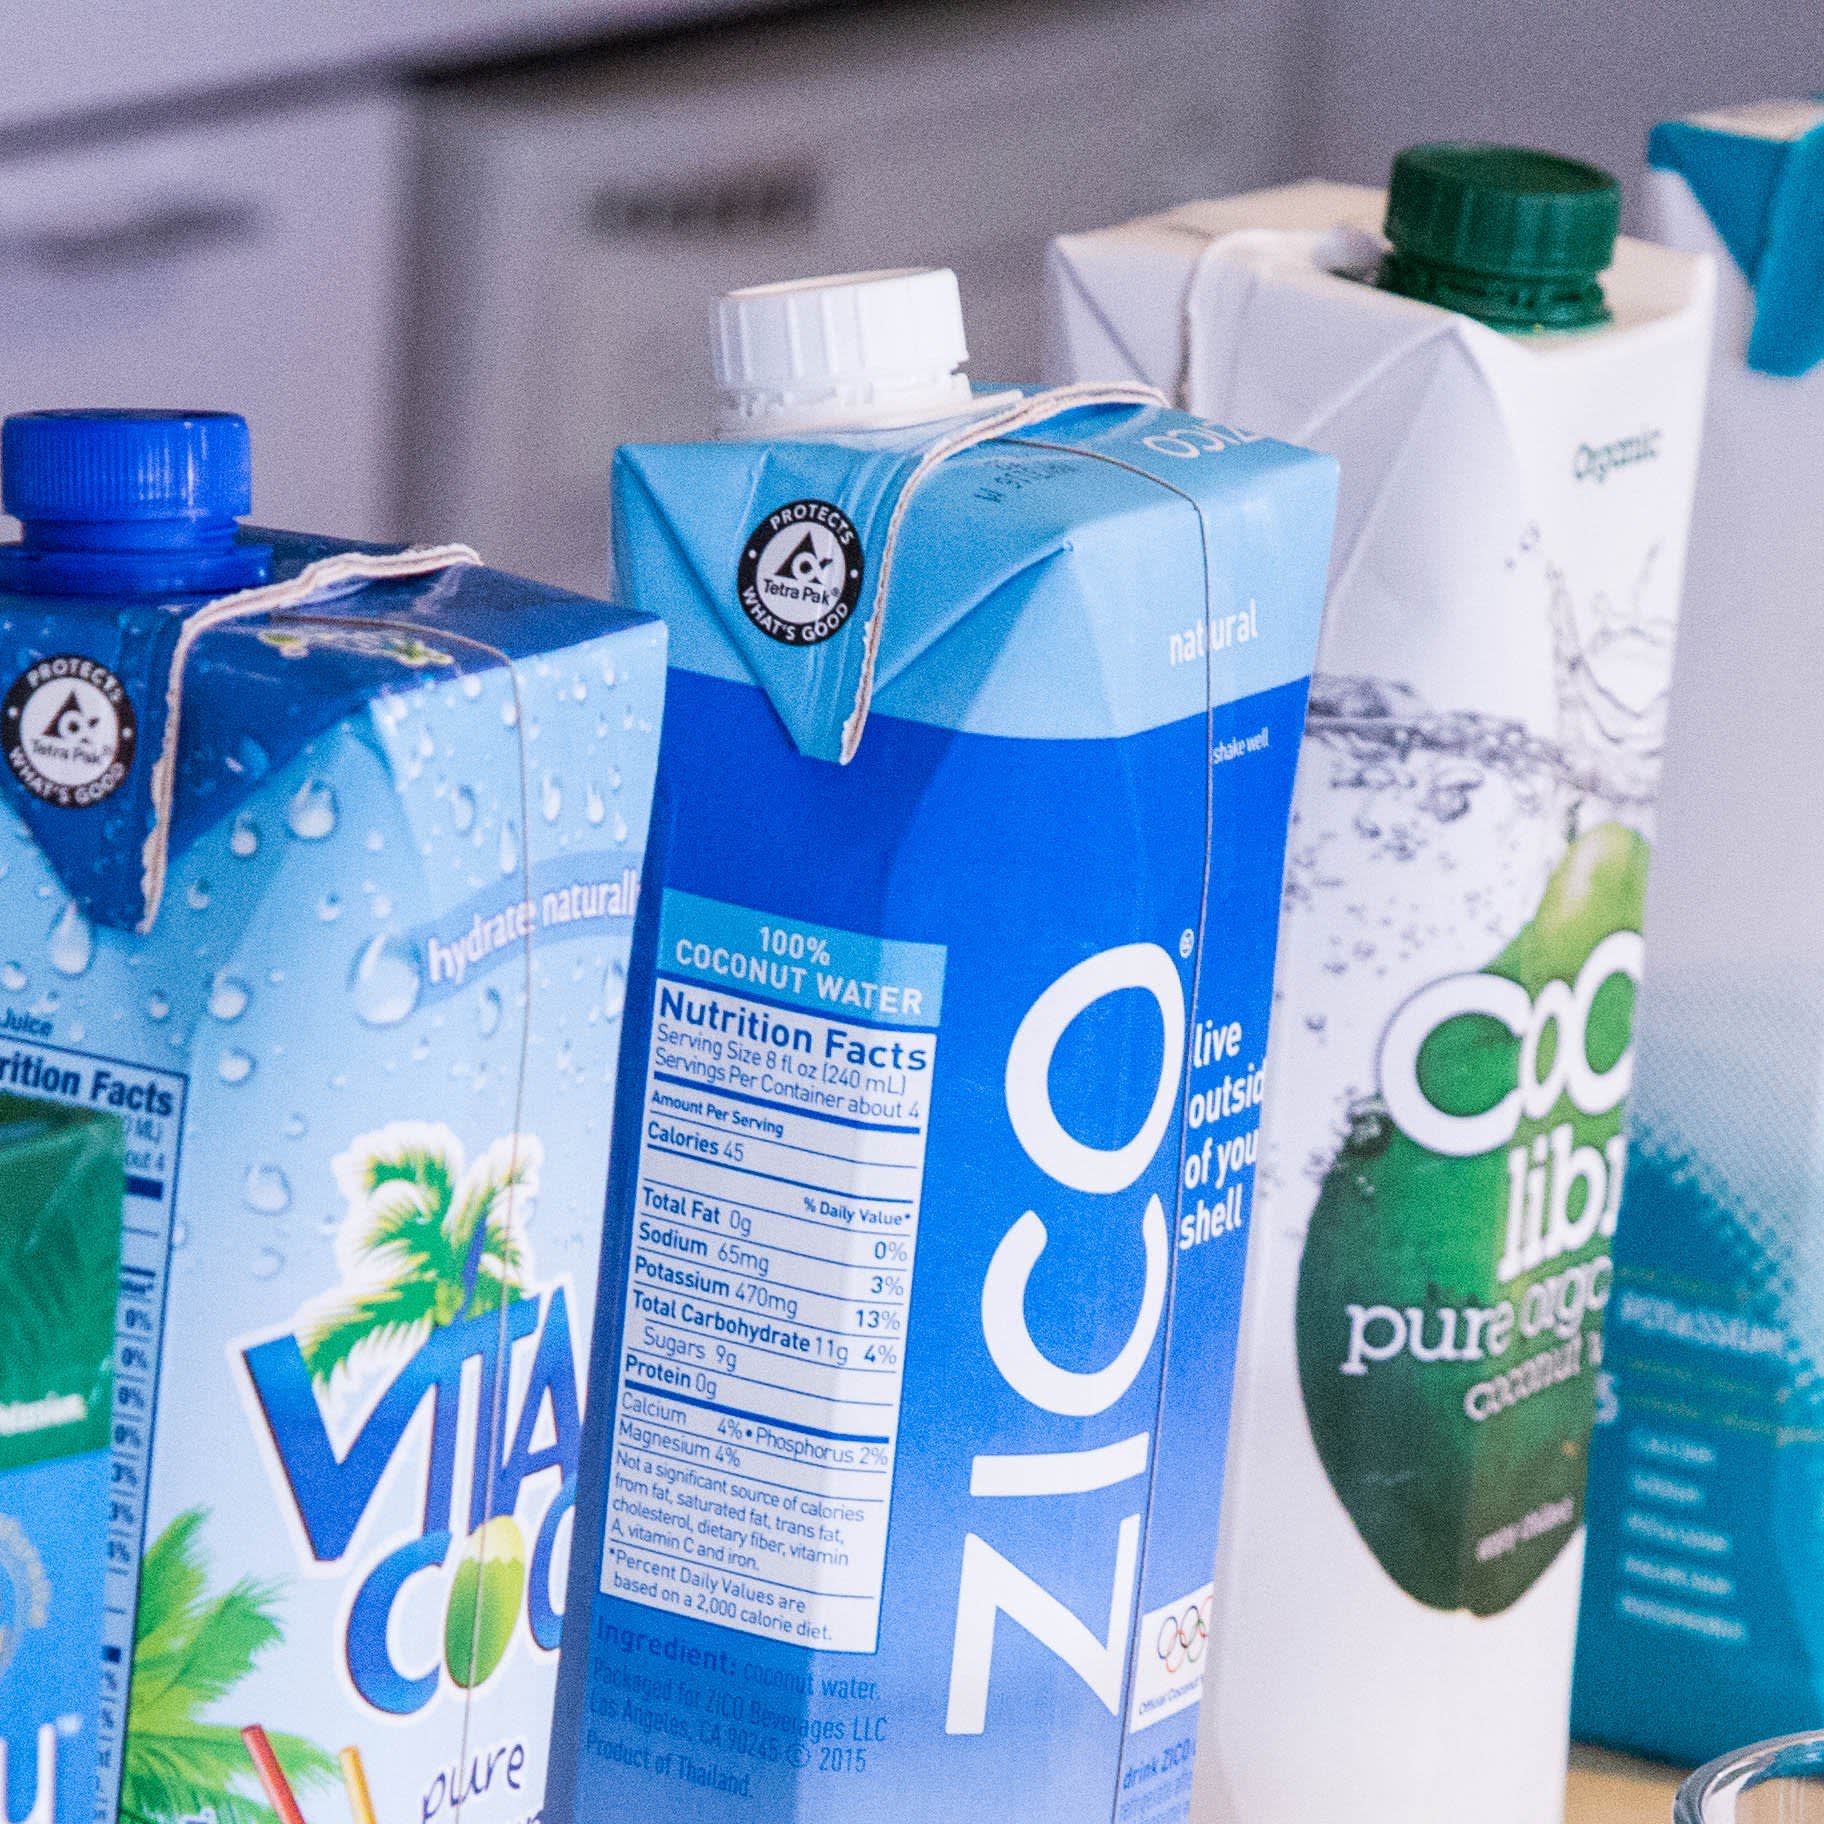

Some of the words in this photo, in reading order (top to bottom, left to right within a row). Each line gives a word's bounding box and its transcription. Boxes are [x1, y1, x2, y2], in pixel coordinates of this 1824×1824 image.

[770, 504, 854, 545] PROTECTS
[743, 586, 795, 640] WHAT'S
[802, 603, 848, 641] GOOD
[764, 579, 799, 599] Tetra
[803, 587, 830, 605] Pak
[1170, 598, 1258, 666] natural
[27, 659, 123, 702] PROTECTS
[1214, 736, 1245, 764] shake
[1247, 726, 1269, 752] well
[75, 762, 125, 805] GOOD
[428, 891, 534, 984] hydrate
[760, 926, 830, 966] 100%
[676, 938, 807, 993] COCONUT
[817, 971, 922, 1015] WATER
[0, 1007, 54, 1037] Juice
[657, 1023, 721, 1061] Serving
[728, 1041, 762, 1065] Size
[767, 1051, 776, 1069] 8
[781, 1054, 792, 1074] fl
[797, 1063, 816, 1078] oz
[660, 987, 812, 1053] Nutrition
[827, 1029, 926, 1071] Facts
[1193, 1020, 1241, 1069] live
[91, 1070, 174, 1116] Facts
[656, 1048, 724, 1082] Servings
[729, 1068, 757, 1088] Per
[761, 1076, 843, 1110] Container
[848, 1094, 901, 1119] about
[909, 1101, 919, 1118] 4
[1188, 1059, 1266, 1130] outsid
[648, 1122, 719, 1155] Calories
[723, 1143, 744, 1161] 45
[652, 1091, 703, 1117] Amount
[707, 1103, 728, 1121] Per
[732, 1111, 784, 1138] Serving
[1184, 1144, 1214, 1188] of
[643, 1187, 688, 1216] Total
[692, 1201, 719, 1224] Fat
[729, 1209, 751, 1236] 0g
[874, 1241, 907, 1262] 0%
[804, 1197, 816, 1213] %
[820, 1201, 855, 1222] Daily
[1178, 1195, 1242, 1251] shell
[638, 1222, 707, 1256] Sodium
[717, 1242, 769, 1276] 65mg
[871, 1276, 904, 1296] 3%
[634, 1256, 729, 1297] Potassium
[735, 1282, 797, 1318] 470mg
[855, 1310, 900, 1330] 13%
[633, 1290, 675, 1318] Total
[681, 1305, 810, 1351] Carbohydrate
[816, 1338, 848, 1367] 11g
[864, 1345, 896, 1363] 4%
[643, 1327, 705, 1359] Sugars
[715, 1346, 737, 1371] 9g
[946, 942, 1185, 1735] ZICO
[1341, 1299, 1515, 1376] pure
[626, 1355, 691, 1388] Protein
[696, 1372, 717, 1399] 0g
[619, 1420, 710, 1459] Magnesium
[714, 1445, 740, 1467] 4%
[622, 1392, 687, 1424] Calcium
[717, 1418, 742, 1440] 4%
[756, 1422, 854, 1463] Phosphorus
[859, 1446, 888, 1466] 2%
[616, 1473, 648, 1496] from
[652, 1482, 670, 1504] fat,
[677, 1490, 746, 1521] saturated
[750, 1508, 771, 1529] fat,
[775, 1517, 814, 1538] trans
[819, 1523, 844, 1544] fat,
[617, 1451, 641, 1472] Not
[644, 1460, 652, 1474] a
[656, 1460, 727, 1495] significant
[730, 1484, 780, 1506] source
[783, 1492, 797, 1512] of
[800, 1498, 864, 1521] calories
[611, 1519, 624, 1538] A,
[628, 1526, 680, 1548] vitamin
[683, 1538, 695, 1553] C
[697, 1542, 724, 1561] and
[727, 1549, 759, 1570] iron.
[612, 1499, 693, 1531] cholesterol,
[697, 1518, 746, 1548] dietary
[750, 1534, 785, 1556] fiber,
[789, 1540, 848, 1566] vitamin
[614, 1573, 657, 1599] based
[661, 1588, 679, 1602] on
[683, 1594, 692, 1607] a
[696, 1598, 736, 1620] 2,000
[740, 1606, 792, 1632] calorie
[796, 1620, 832, 1641] diet.
[680, 1562, 718, 1590] Daily
[722, 1578, 775, 1604] Values
[778, 1596, 806, 1612] are
[597, 1616, 736, 1676] Ingredient:
[744, 1662, 814, 1694] coconut
[821, 1676, 881, 1700] water.
[590, 1691, 619, 1715] Los
[699, 1722, 721, 1747] CA
[818, 1748, 866, 1772] 2015
[593, 1660, 672, 1700] Packaged
[678, 1682, 700, 1706] for
[706, 1689, 743, 1720] ZICO
[750, 1700, 844, 1745] Beverages
[851, 1718, 886, 1742] LLC
[586, 1730, 650, 1770] Product
[655, 1752, 672, 1775] of
[677, 1754, 753, 1799] Thailand.
